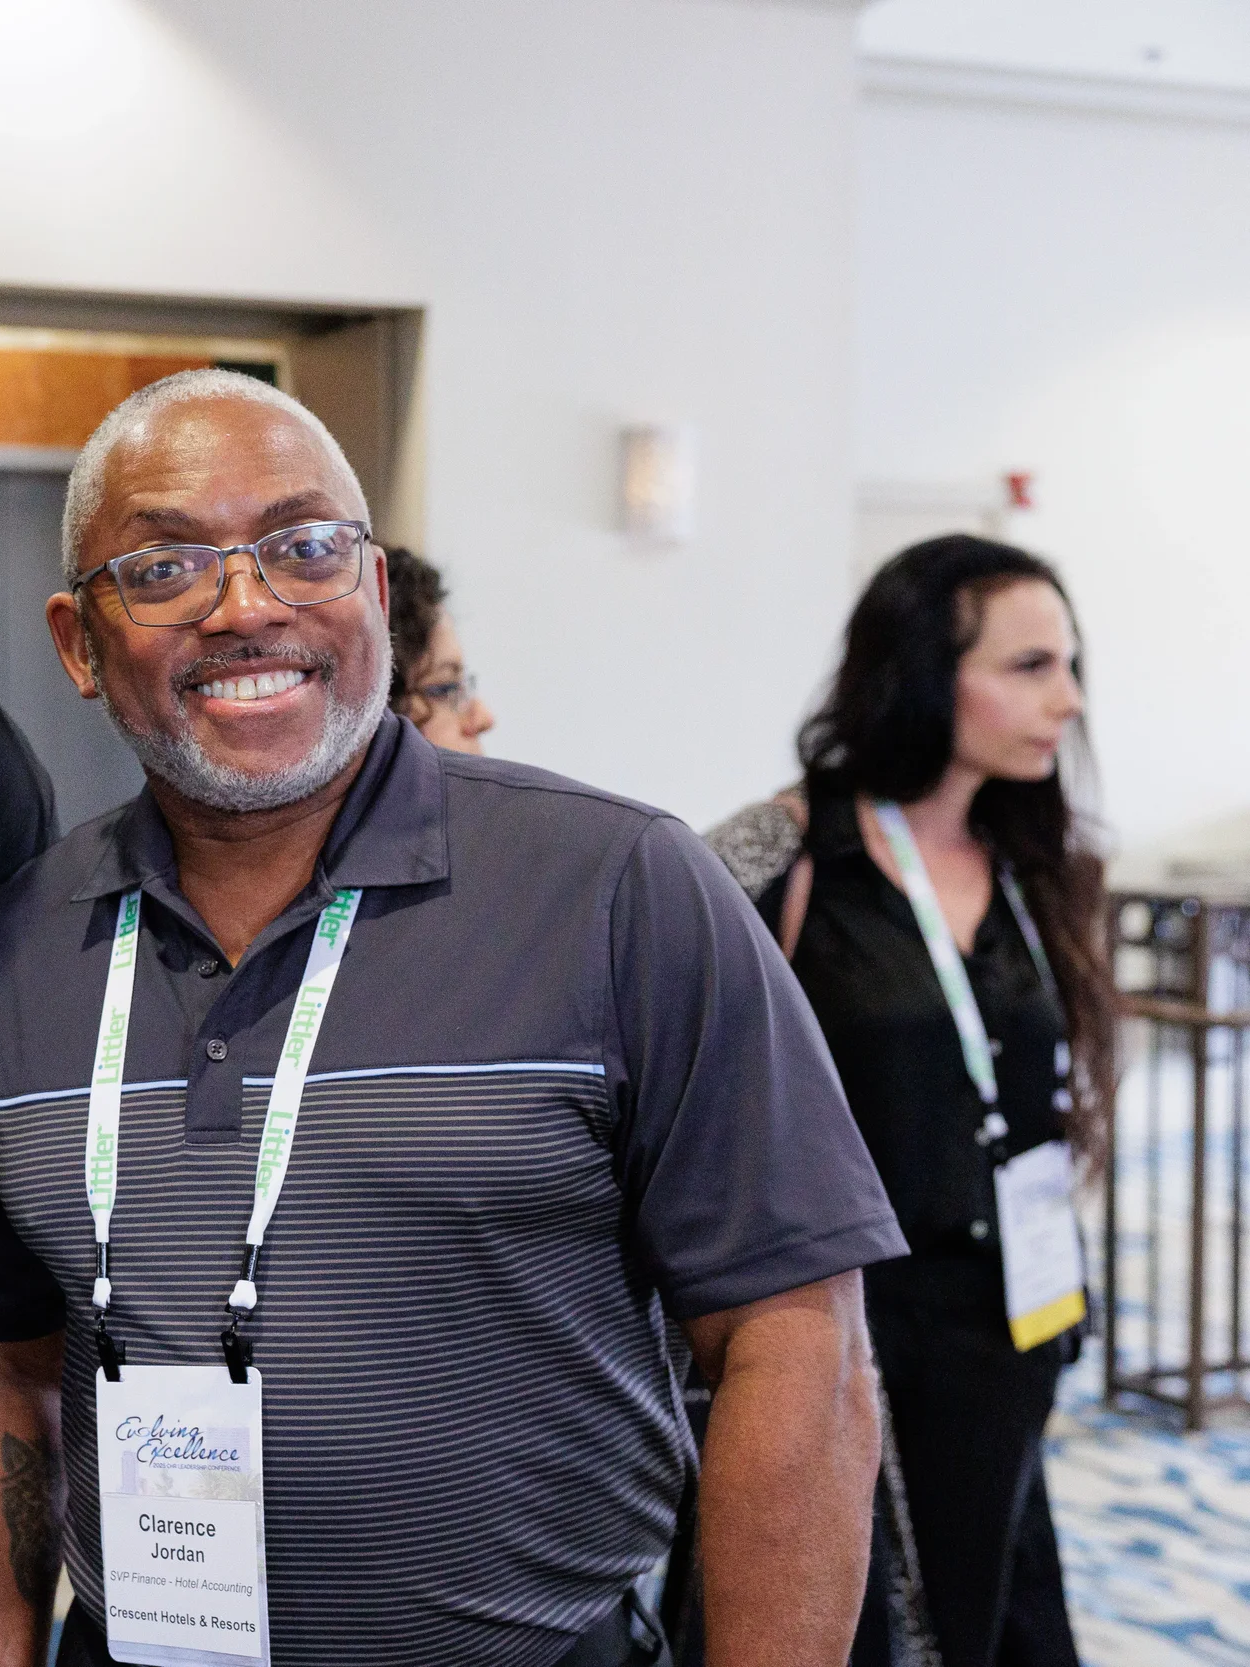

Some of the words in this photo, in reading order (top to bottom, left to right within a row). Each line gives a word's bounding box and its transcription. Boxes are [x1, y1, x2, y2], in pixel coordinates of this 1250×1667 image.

[319, 889, 356, 950] ttler
[284, 985, 327, 1067] Littler
[96, 1006, 127, 1084] Littler
[257, 1110, 294, 1197] Littler
[89, 1127, 115, 1211] Littler
[115, 1414, 204, 1441] Evolving
[136, 1436, 240, 1467] Excellence
[208, 1464, 241, 1473] CONFERENCE
[138, 1513, 217, 1538] Clarence
[150, 1542, 206, 1564] Jordan
[110, 1570, 130, 1582] SVP
[131, 1572, 167, 1586] Finance
[175, 1576, 199, 1589] Hotel
[201, 1579, 254, 1597] Accounting
[109, 1605, 158, 1622] Crescent
[160, 1610, 197, 1627] Hotels
[200, 1614, 208, 1628] &
[211, 1616, 257, 1634] Resorts
